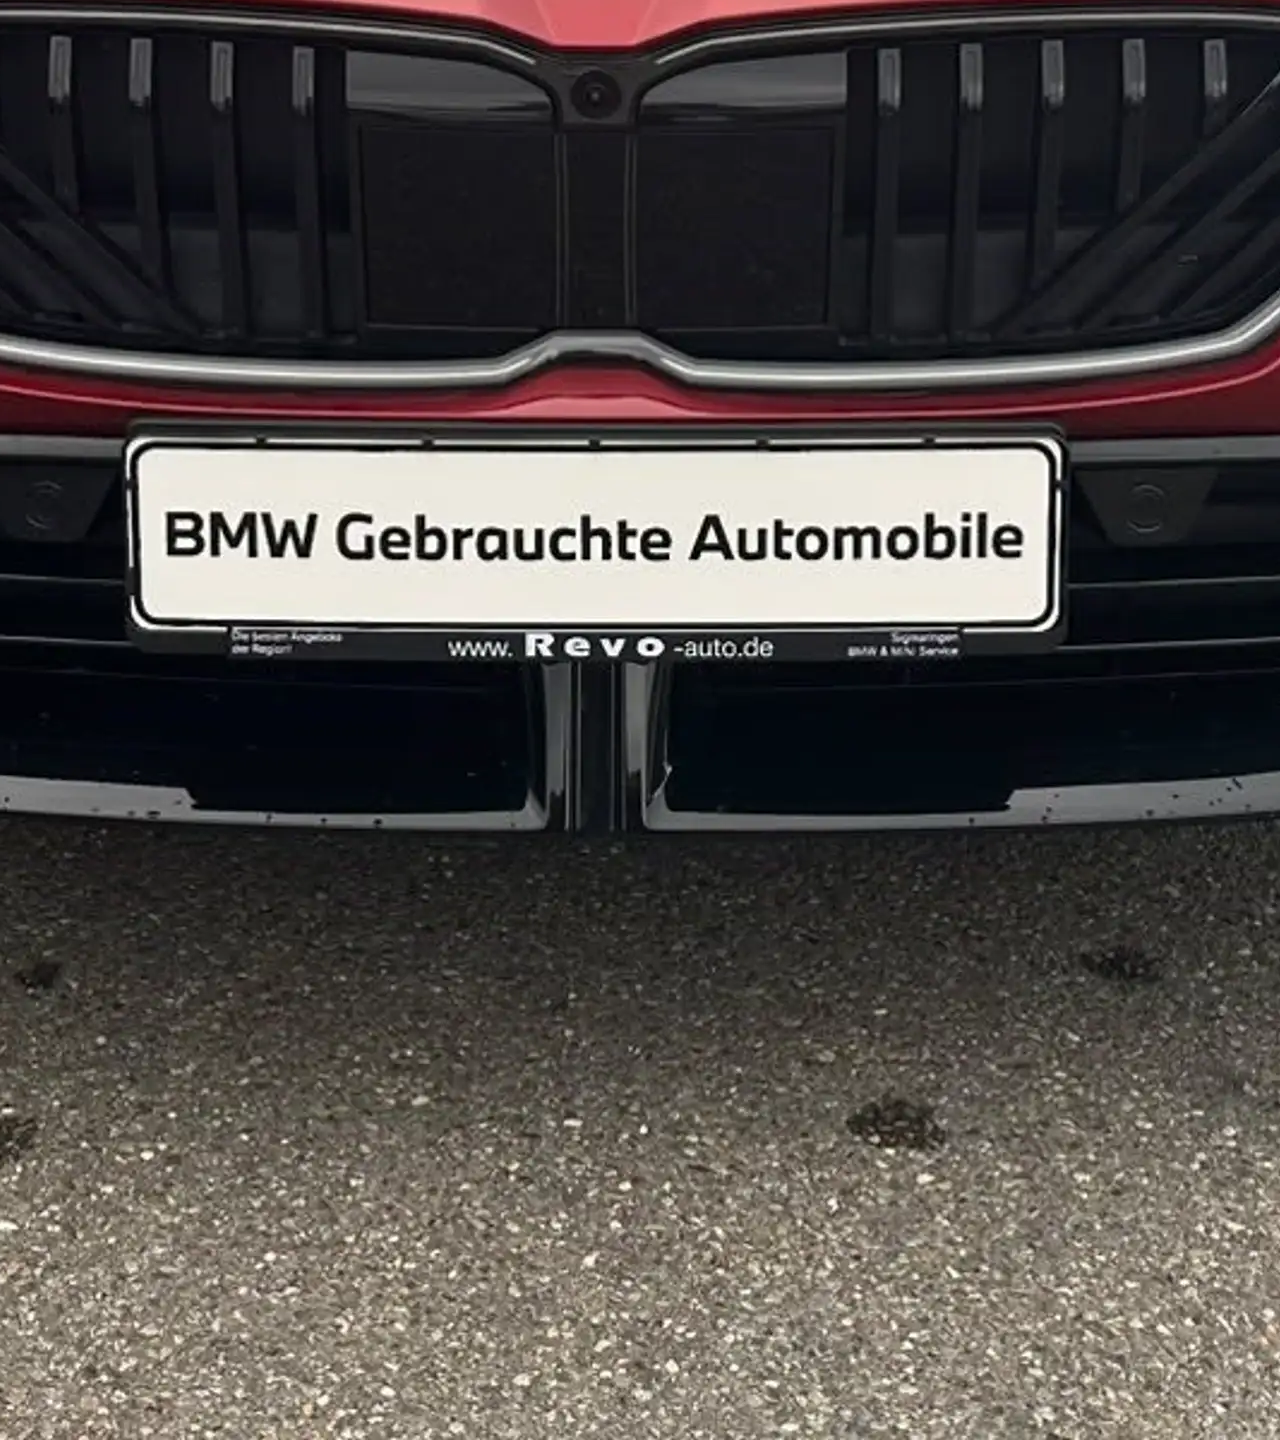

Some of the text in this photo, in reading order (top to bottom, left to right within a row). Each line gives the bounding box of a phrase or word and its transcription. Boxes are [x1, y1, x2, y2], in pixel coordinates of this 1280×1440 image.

[165, 511, 1024, 561] BMW Gebrauchte Automobile
